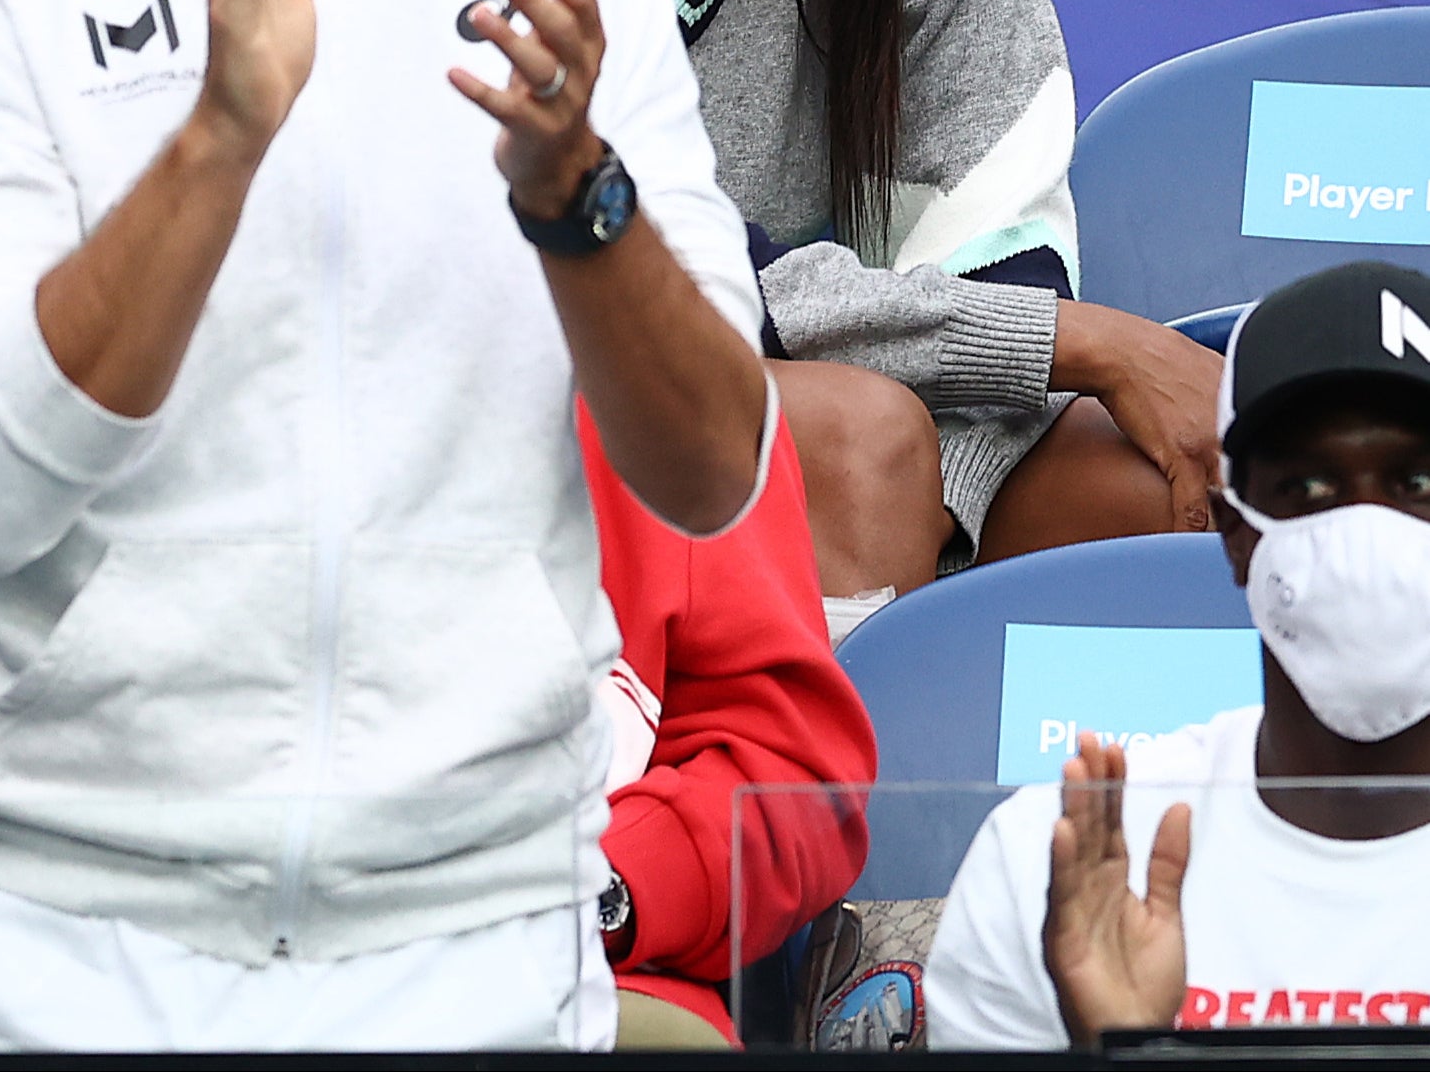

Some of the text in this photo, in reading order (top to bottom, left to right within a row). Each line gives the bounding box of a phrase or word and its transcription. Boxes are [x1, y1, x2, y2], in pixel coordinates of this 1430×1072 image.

[1283, 172, 1414, 219] Player
[1039, 719, 1168, 755] Plye
[1174, 986, 1430, 1030] REATEST
